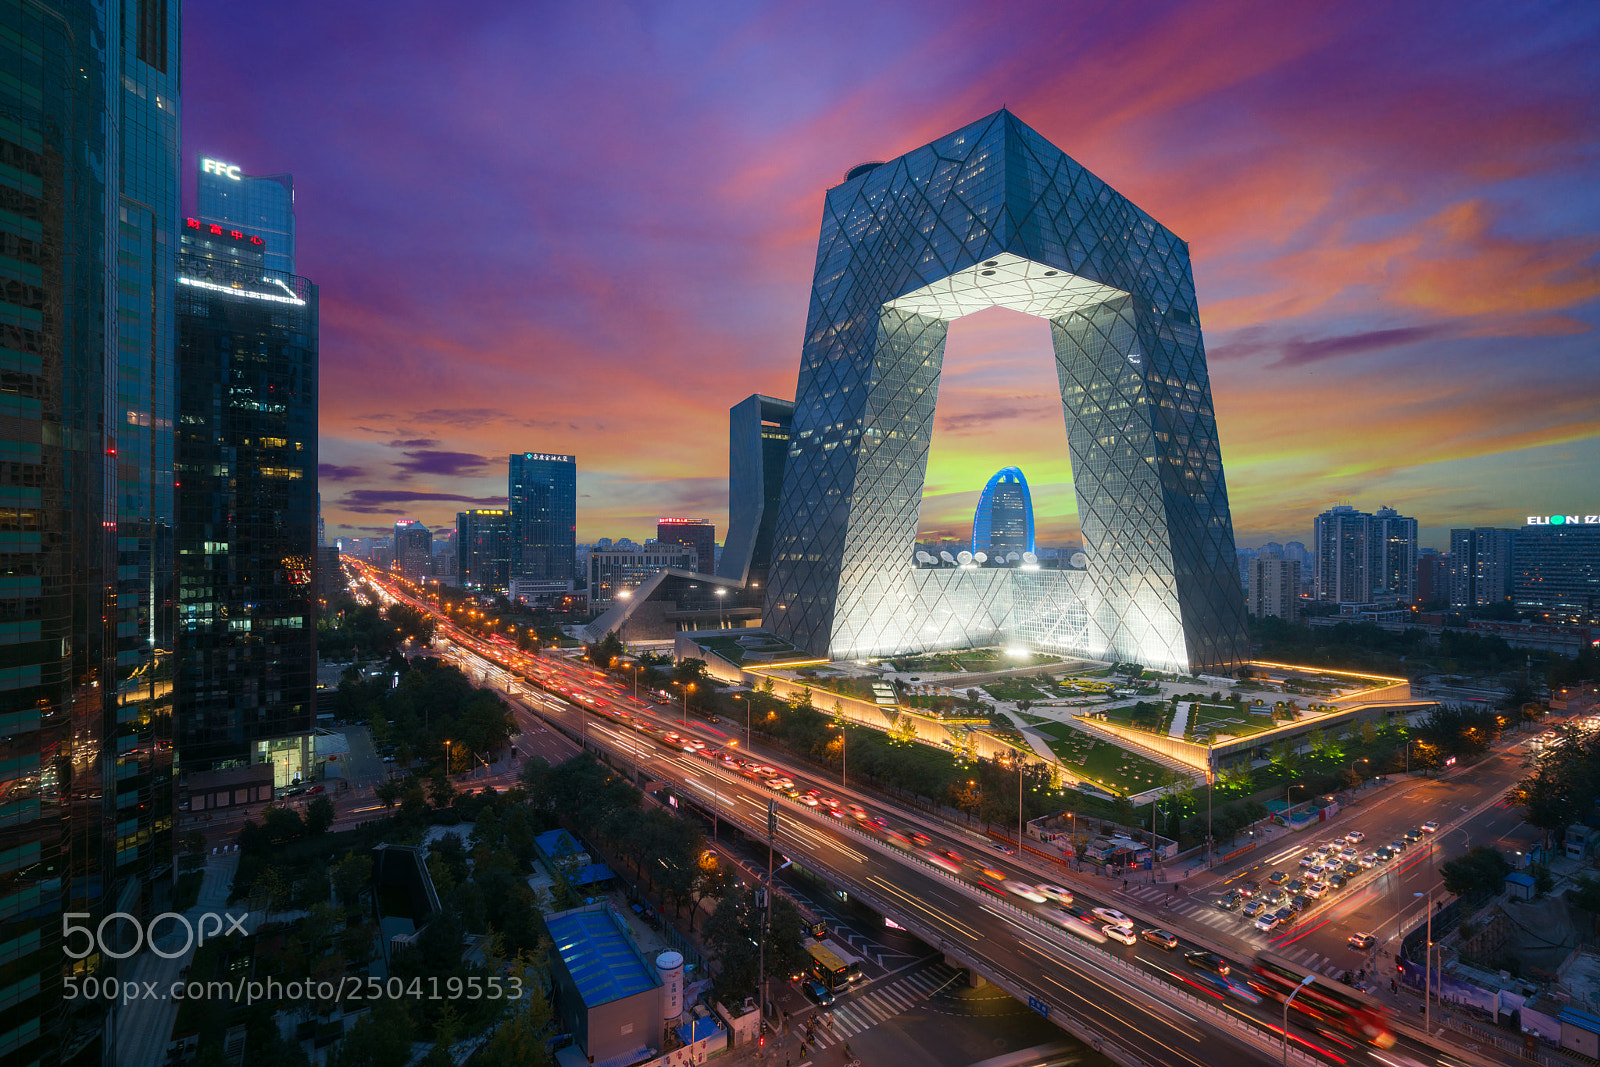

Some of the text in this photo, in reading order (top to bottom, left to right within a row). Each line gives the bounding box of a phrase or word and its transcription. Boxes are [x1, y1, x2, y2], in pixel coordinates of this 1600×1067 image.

[202, 158, 241, 181] FFC
[187, 217, 263, 245] 财富中心
[1527, 514, 1579, 525] ELION
